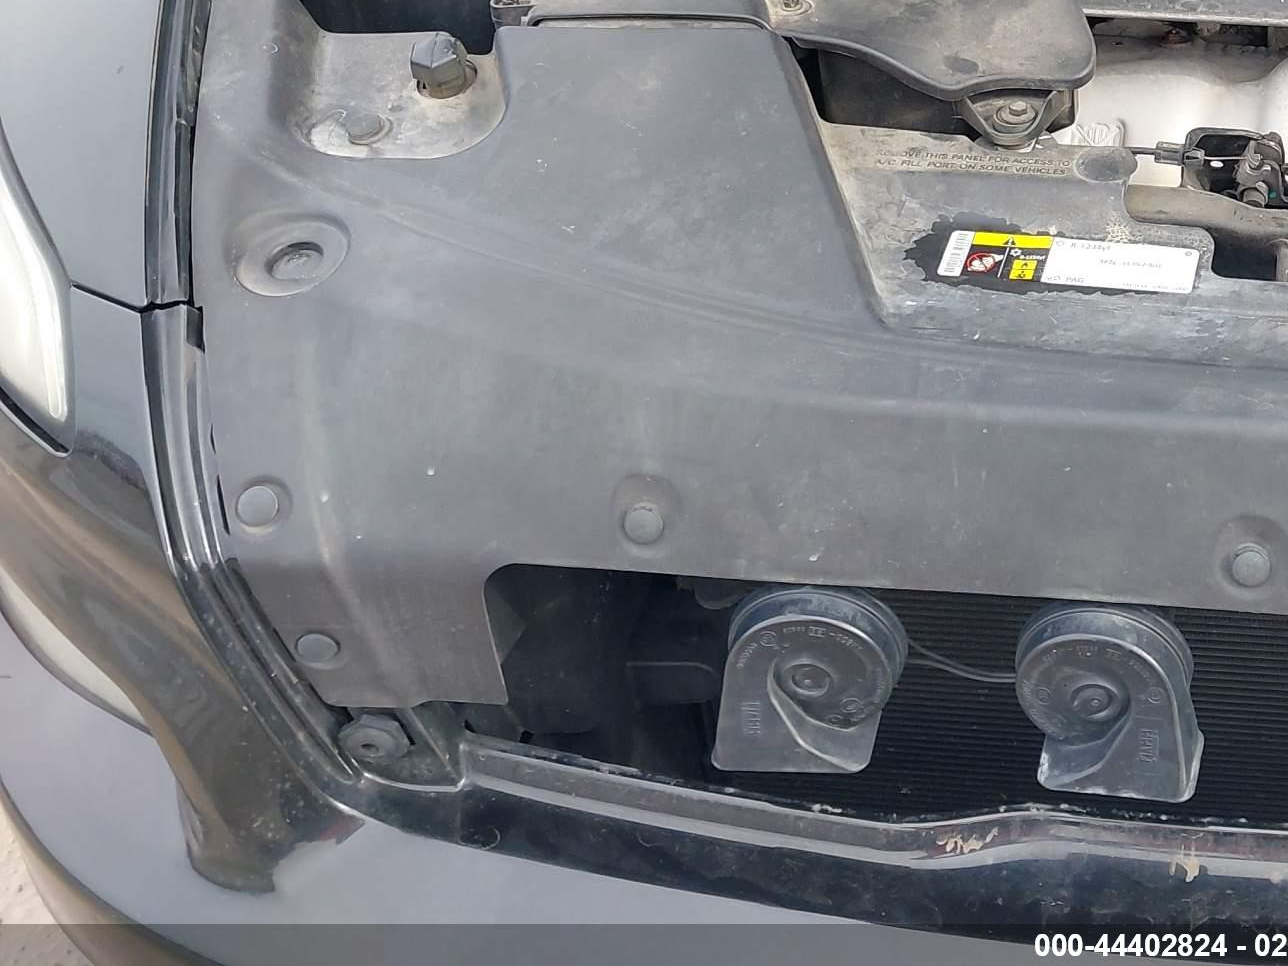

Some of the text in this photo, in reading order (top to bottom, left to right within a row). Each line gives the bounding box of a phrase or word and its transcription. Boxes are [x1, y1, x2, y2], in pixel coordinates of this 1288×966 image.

[876, 147, 1071, 167] REOVE THIS PANEL FOR ACCESS TO
[927, 160, 955, 170] PORT
[958, 162, 976, 170] ON
[978, 163, 1014, 172] SOME
[1015, 165, 1067, 176] VEHICLES
